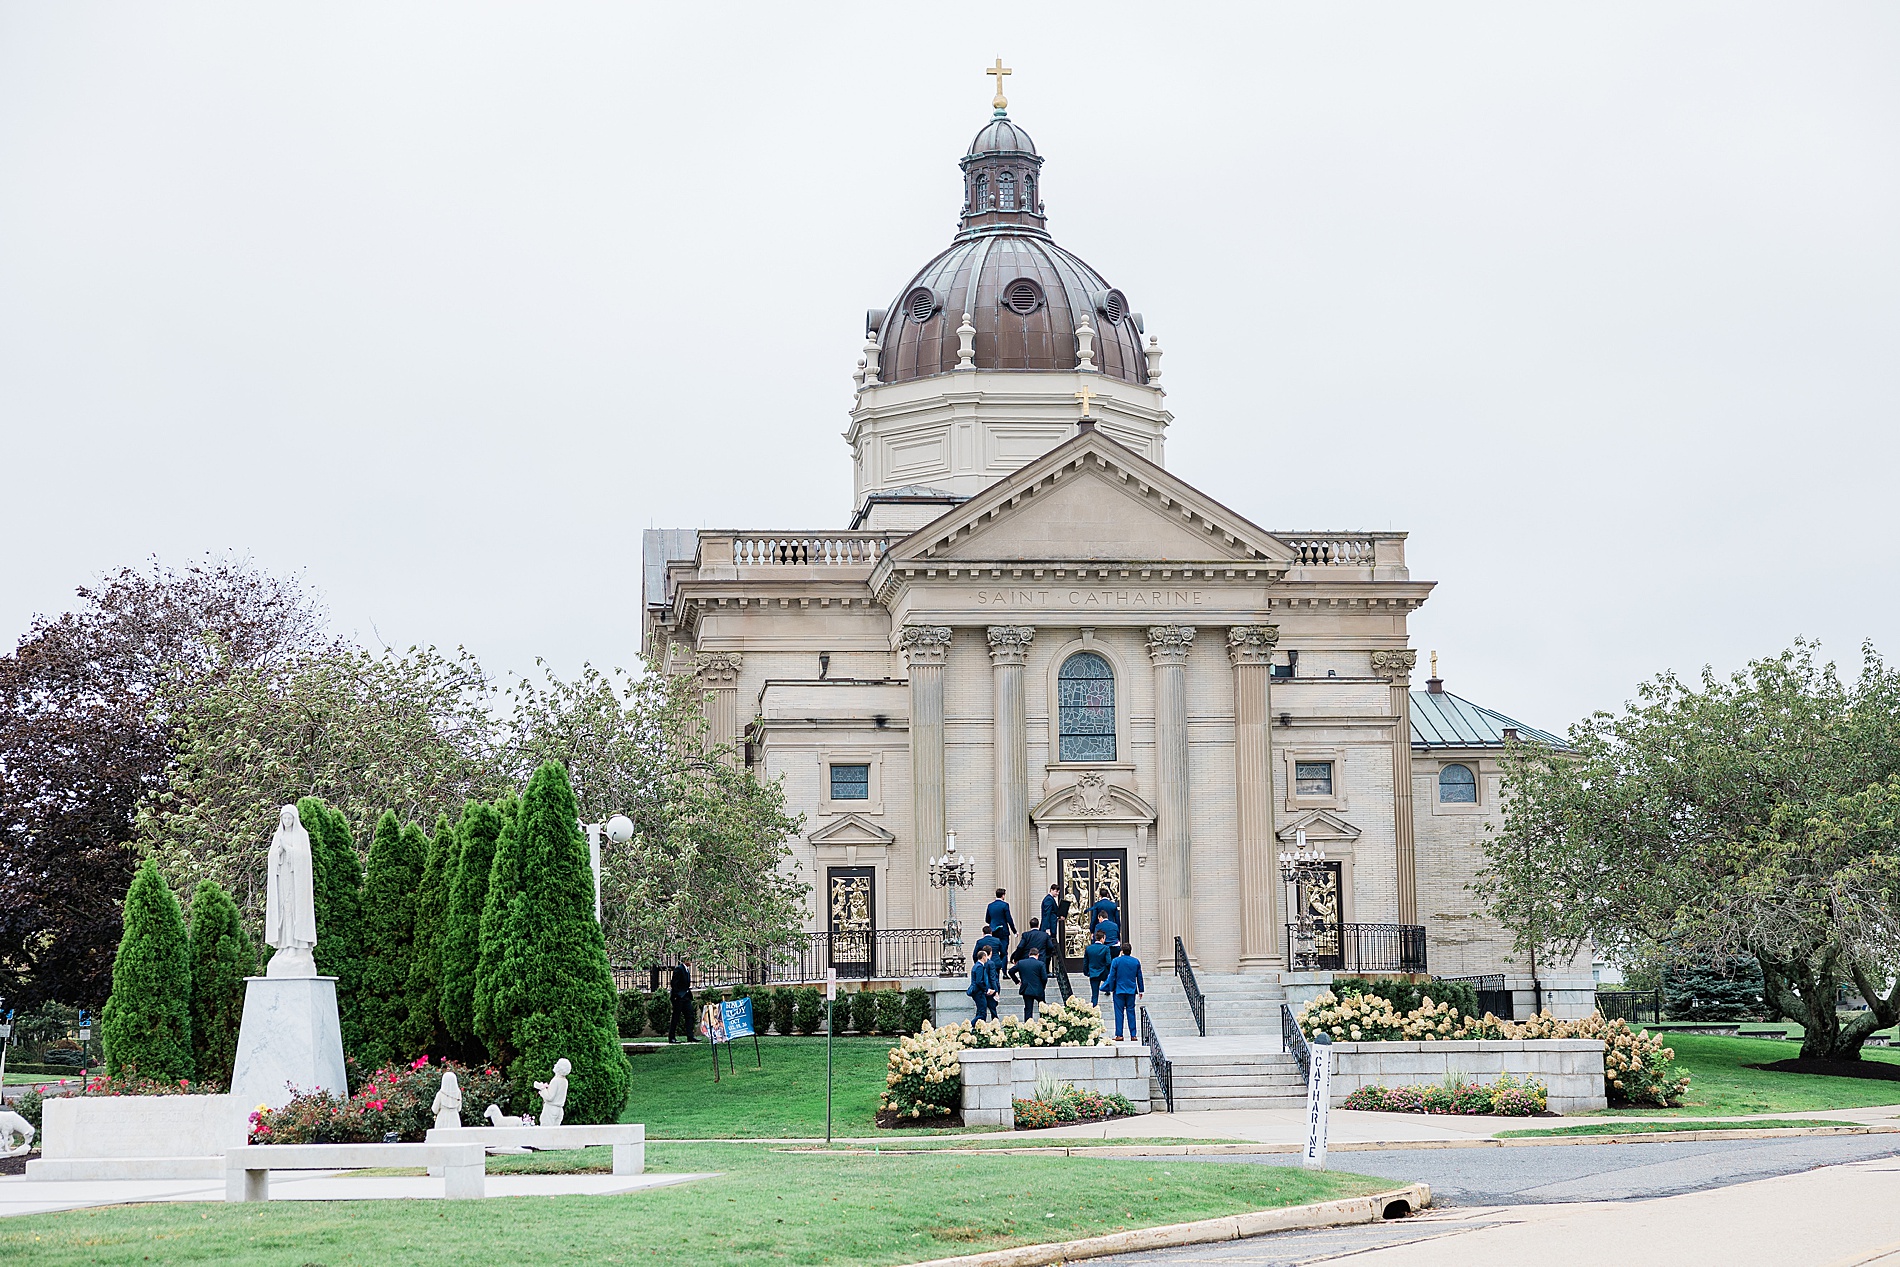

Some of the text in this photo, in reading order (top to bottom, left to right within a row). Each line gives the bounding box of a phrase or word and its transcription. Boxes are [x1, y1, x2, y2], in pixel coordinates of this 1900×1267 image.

[978, 591, 1203, 605] SAINT CATHARINE
[1308, 1056, 1322, 1158] CATHARINE
[139, 1112, 153, 1123] OF
